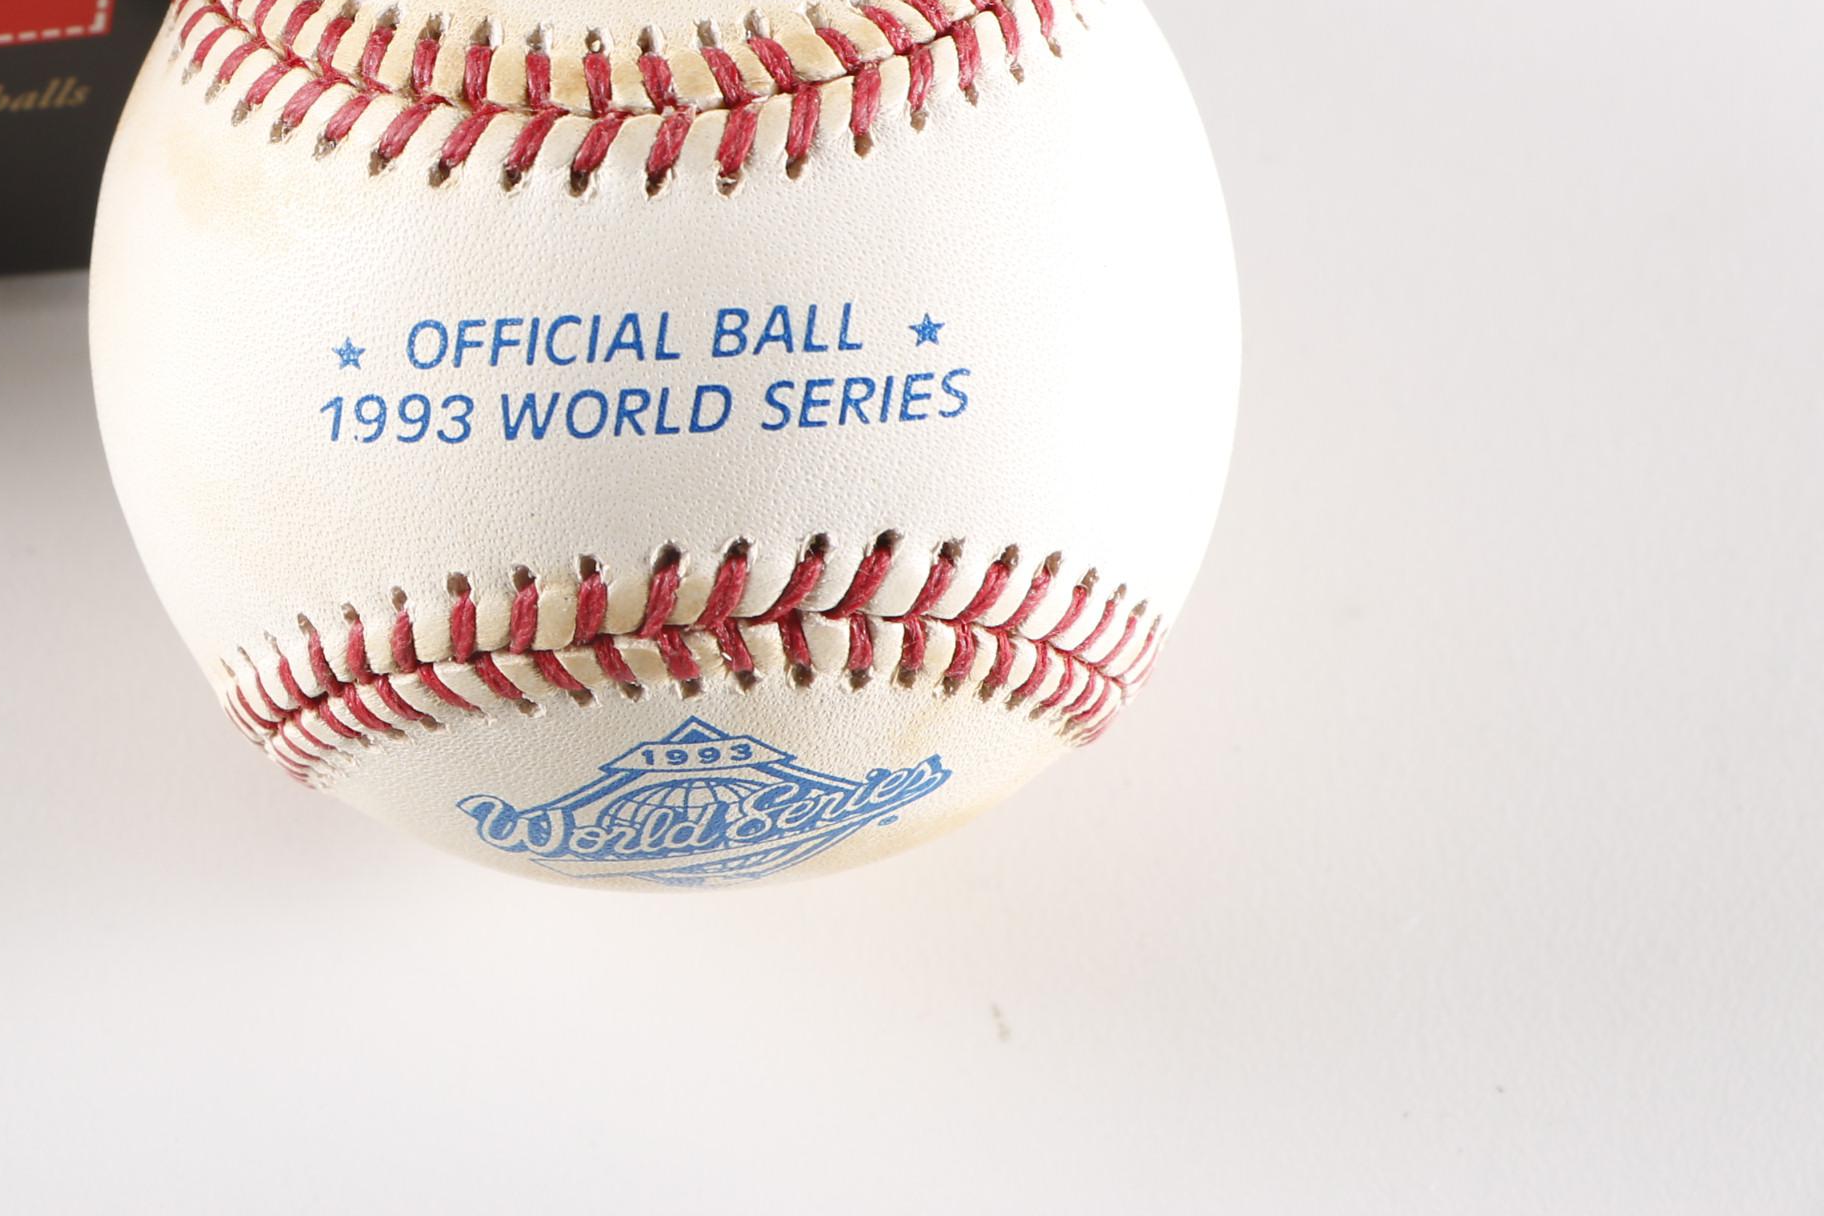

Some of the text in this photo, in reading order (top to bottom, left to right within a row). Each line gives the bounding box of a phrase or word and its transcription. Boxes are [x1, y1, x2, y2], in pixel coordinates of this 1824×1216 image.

[407, 302, 863, 370] OFFICIAL BALL
[319, 367, 971, 444] 1993 WORLD SERIES
[641, 743, 753, 767] 1993
[456, 754, 953, 862] World Series
